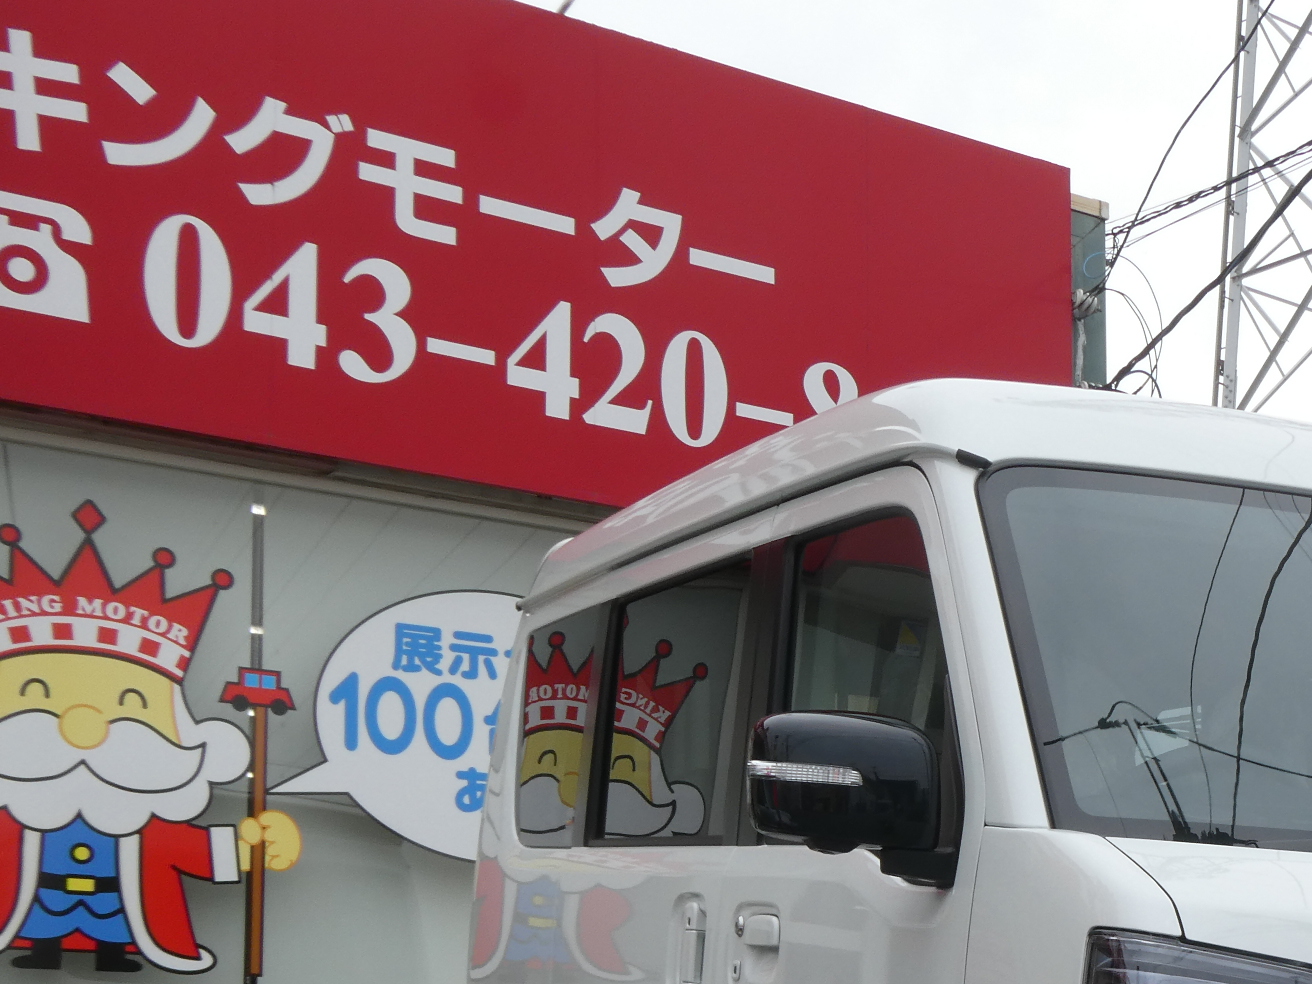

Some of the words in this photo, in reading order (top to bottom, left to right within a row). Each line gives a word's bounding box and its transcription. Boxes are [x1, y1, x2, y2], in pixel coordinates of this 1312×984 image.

[0, 28, 776, 287] キングモーター
[75, 596, 189, 646] MOTOR
[391, 622, 512, 681] 展示
[328, 671, 501, 761] 100
